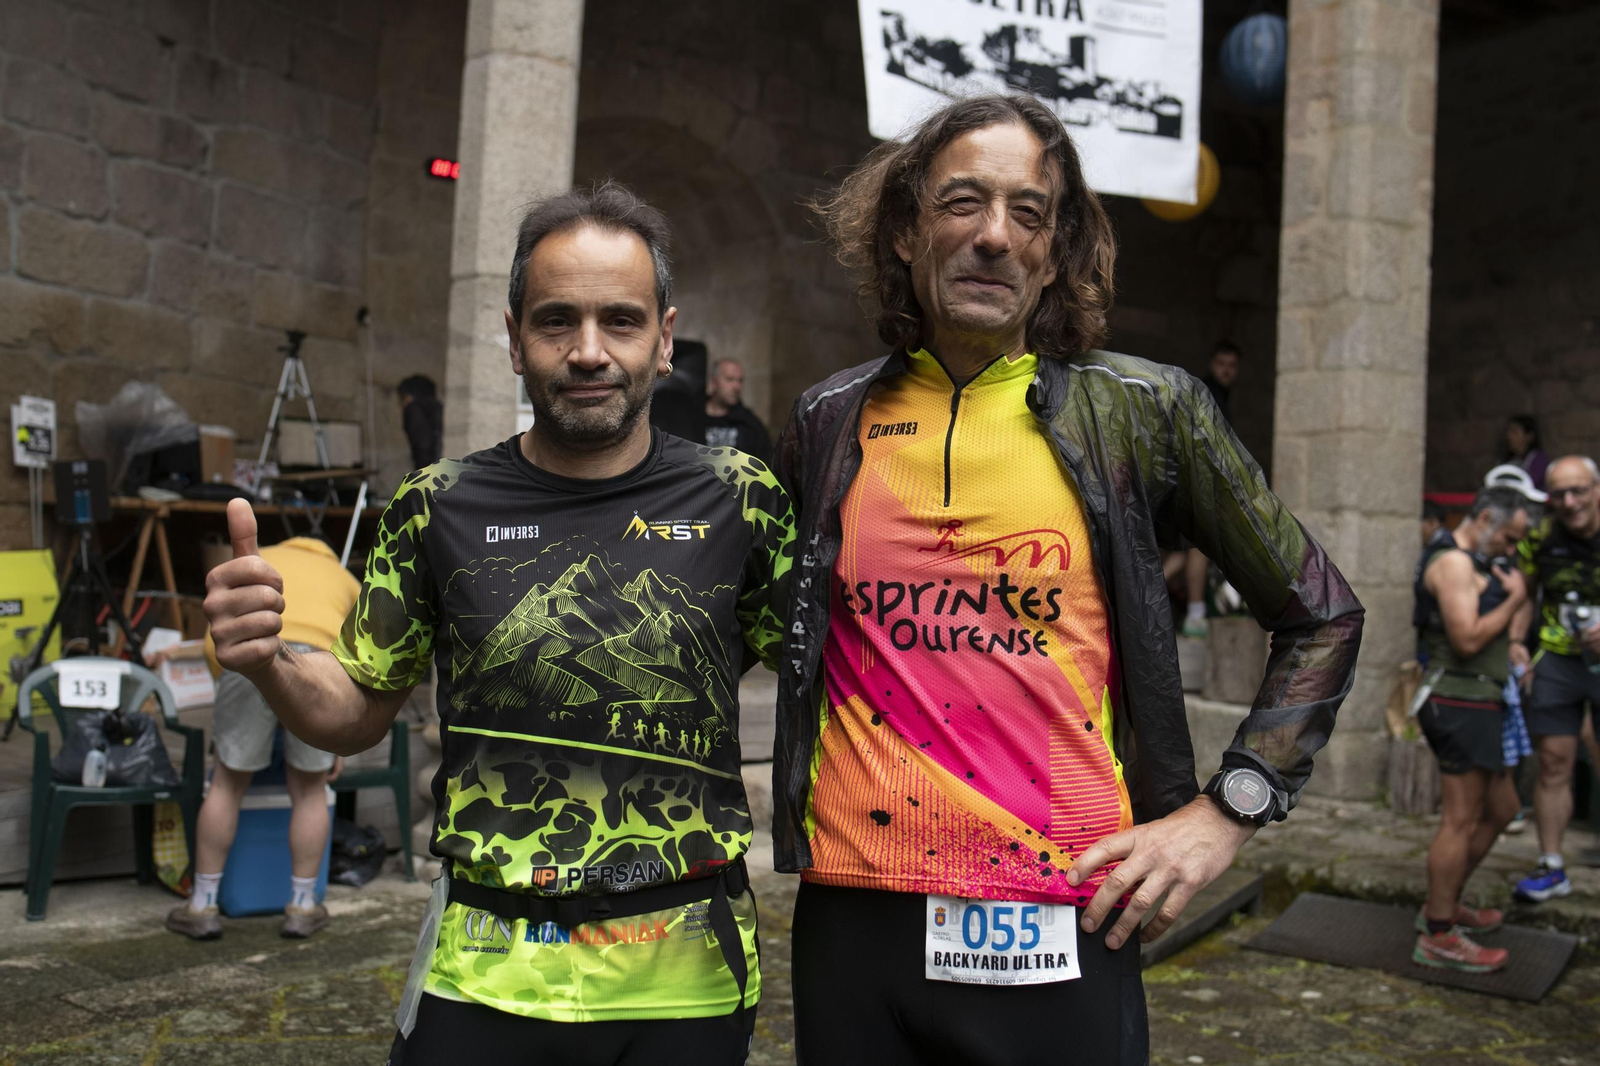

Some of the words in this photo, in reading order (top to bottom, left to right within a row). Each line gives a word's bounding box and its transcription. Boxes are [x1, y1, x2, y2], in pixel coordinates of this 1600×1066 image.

[650, 524, 711, 540] RST
[72, 680, 107, 697] 153
[567, 860, 665, 888] PERSAN
[524, 918, 670, 946] RUNMANIAK
[962, 904, 1041, 951] 055
[934, 951, 1008, 971] BACKYARD
[1013, 952, 1069, 970] ULTRA
